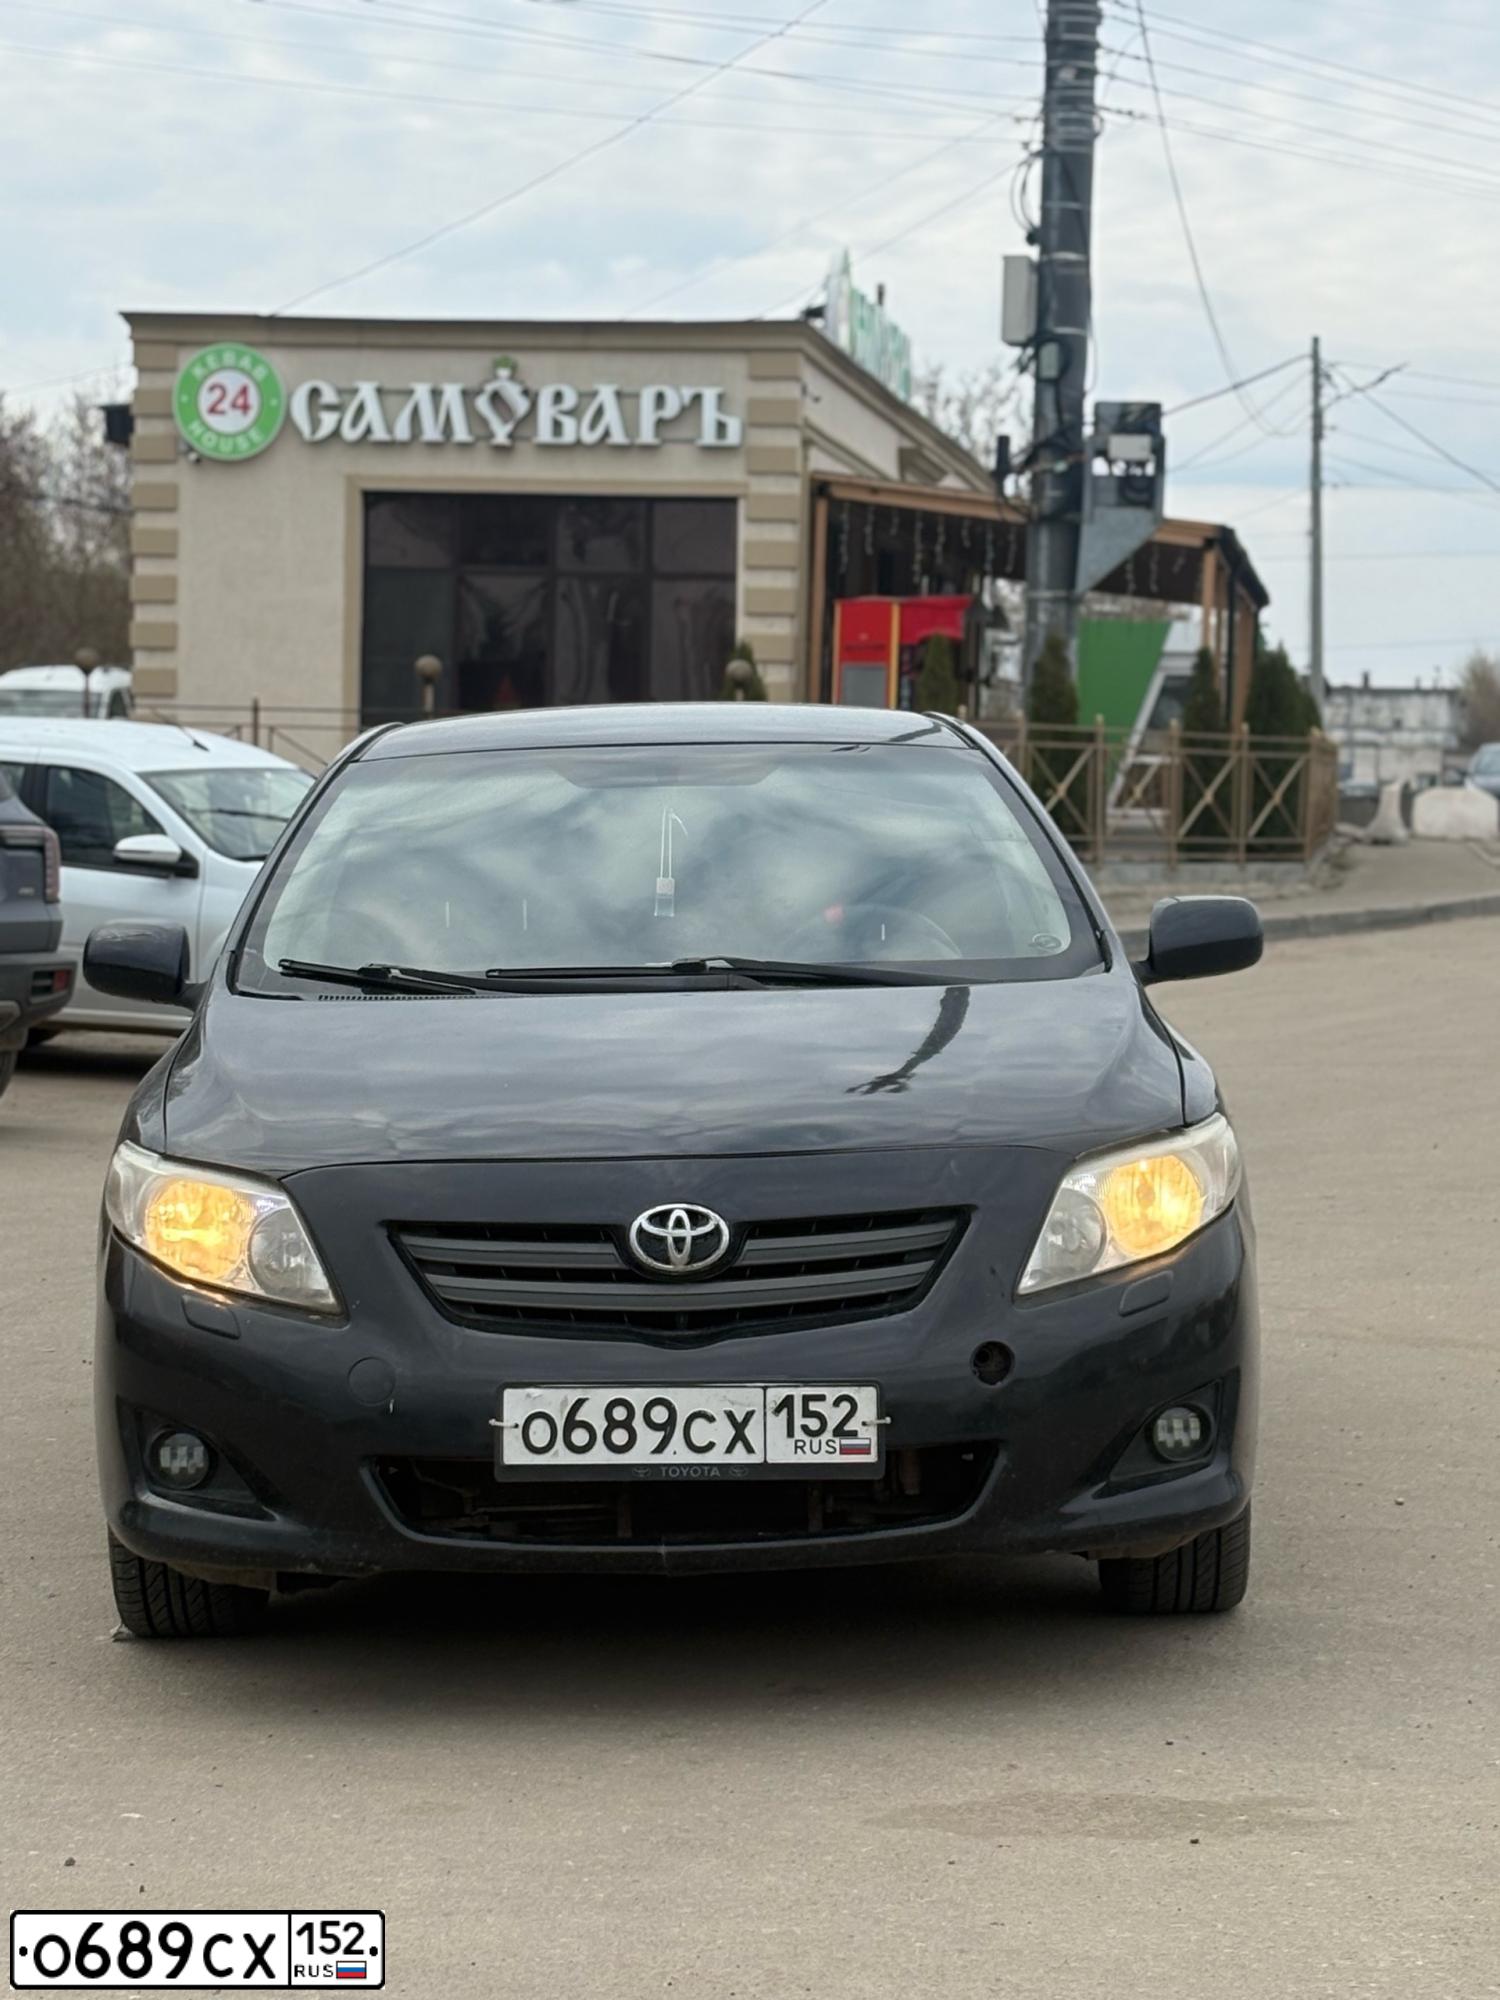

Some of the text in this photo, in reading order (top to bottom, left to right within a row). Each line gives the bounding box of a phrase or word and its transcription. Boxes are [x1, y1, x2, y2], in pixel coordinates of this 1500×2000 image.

[206, 383, 253, 417] 24
[290, 364, 743, 447] САМОВАРЪ
[773, 1394, 859, 1438] 152
[794, 1439, 837, 1455] RUS
[660, 1465, 720, 1478] TOYOTA
